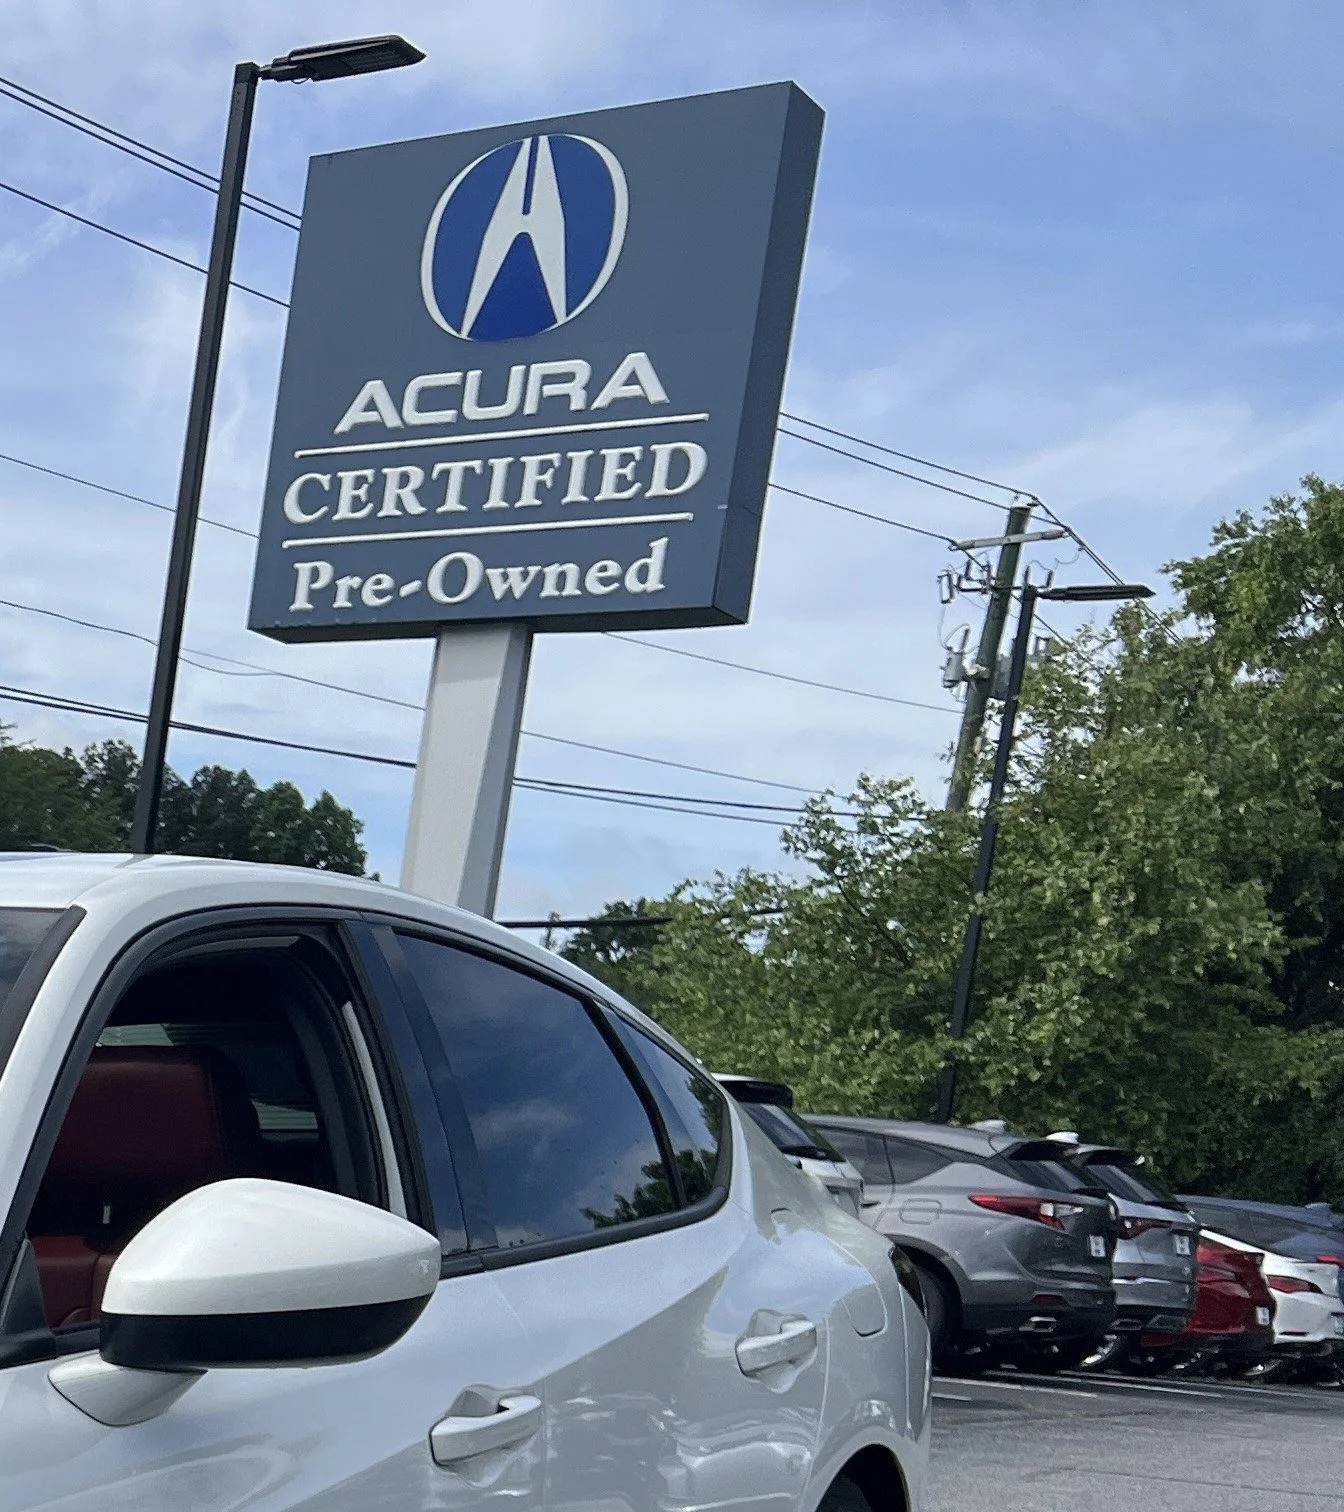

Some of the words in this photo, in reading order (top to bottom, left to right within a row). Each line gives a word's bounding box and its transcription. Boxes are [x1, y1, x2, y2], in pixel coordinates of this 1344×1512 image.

[333, 351, 670, 435] ACURA
[283, 442, 709, 525] CERTIFIED
[288, 536, 670, 612] Pre-Owned
